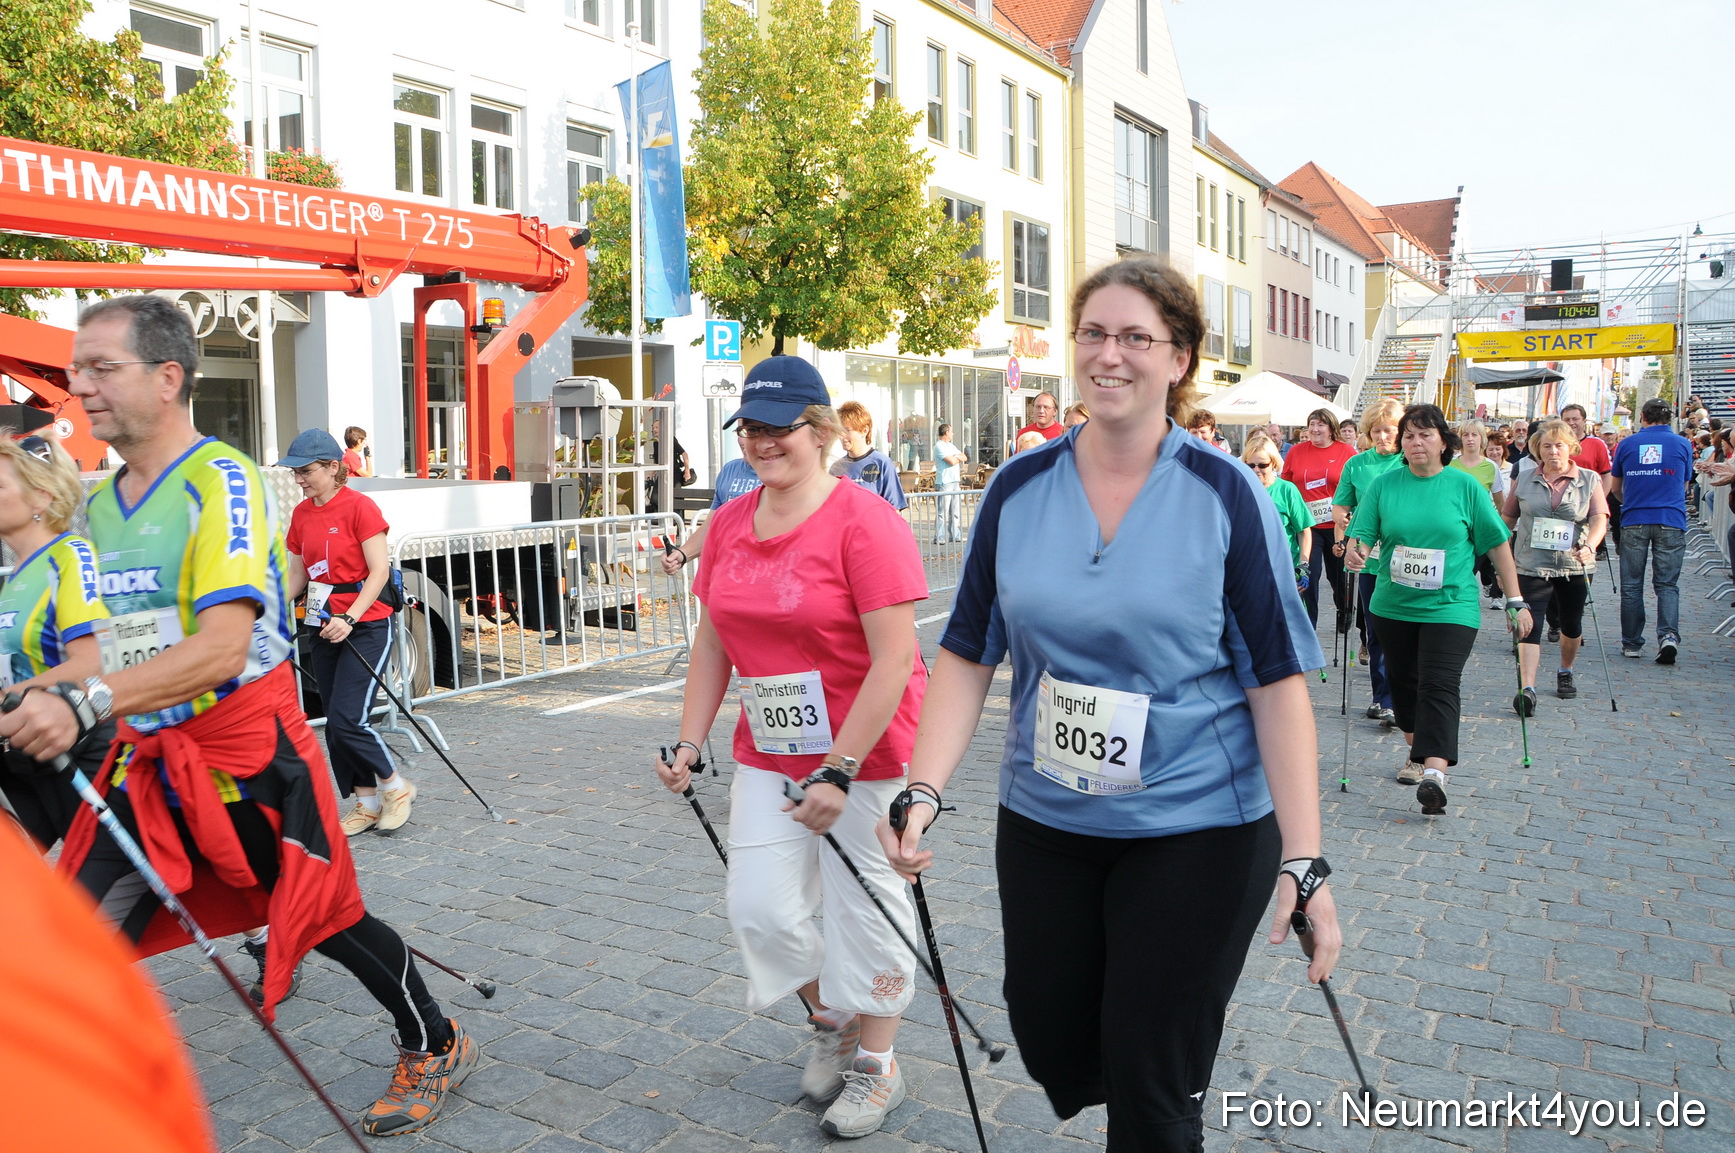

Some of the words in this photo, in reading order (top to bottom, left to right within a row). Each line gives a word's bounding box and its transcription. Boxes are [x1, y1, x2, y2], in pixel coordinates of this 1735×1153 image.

[393, 208, 411, 240] T
[421, 212, 474, 249] 275
[713, 325, 733, 356] P
[1523, 333, 1598, 352] START
[973, 349, 1009, 357] Brunnwirtsgasse
[1626, 468, 1662, 476] neumarkt
[1663, 468, 1676, 476] TV
[207, 457, 254, 559] BOCK
[1543, 529, 1569, 541] 8116
[1404, 549, 1427, 560] Ursula
[1403, 562, 1437, 577] 8041
[99, 566, 163, 597] OCK
[755, 683, 808, 698] Christine
[1053, 687, 1097, 717] Ingrid
[763, 704, 819, 728] 8033
[797, 741, 832, 749] PFLEIDERER
[1055, 721, 1128, 767] 8032
